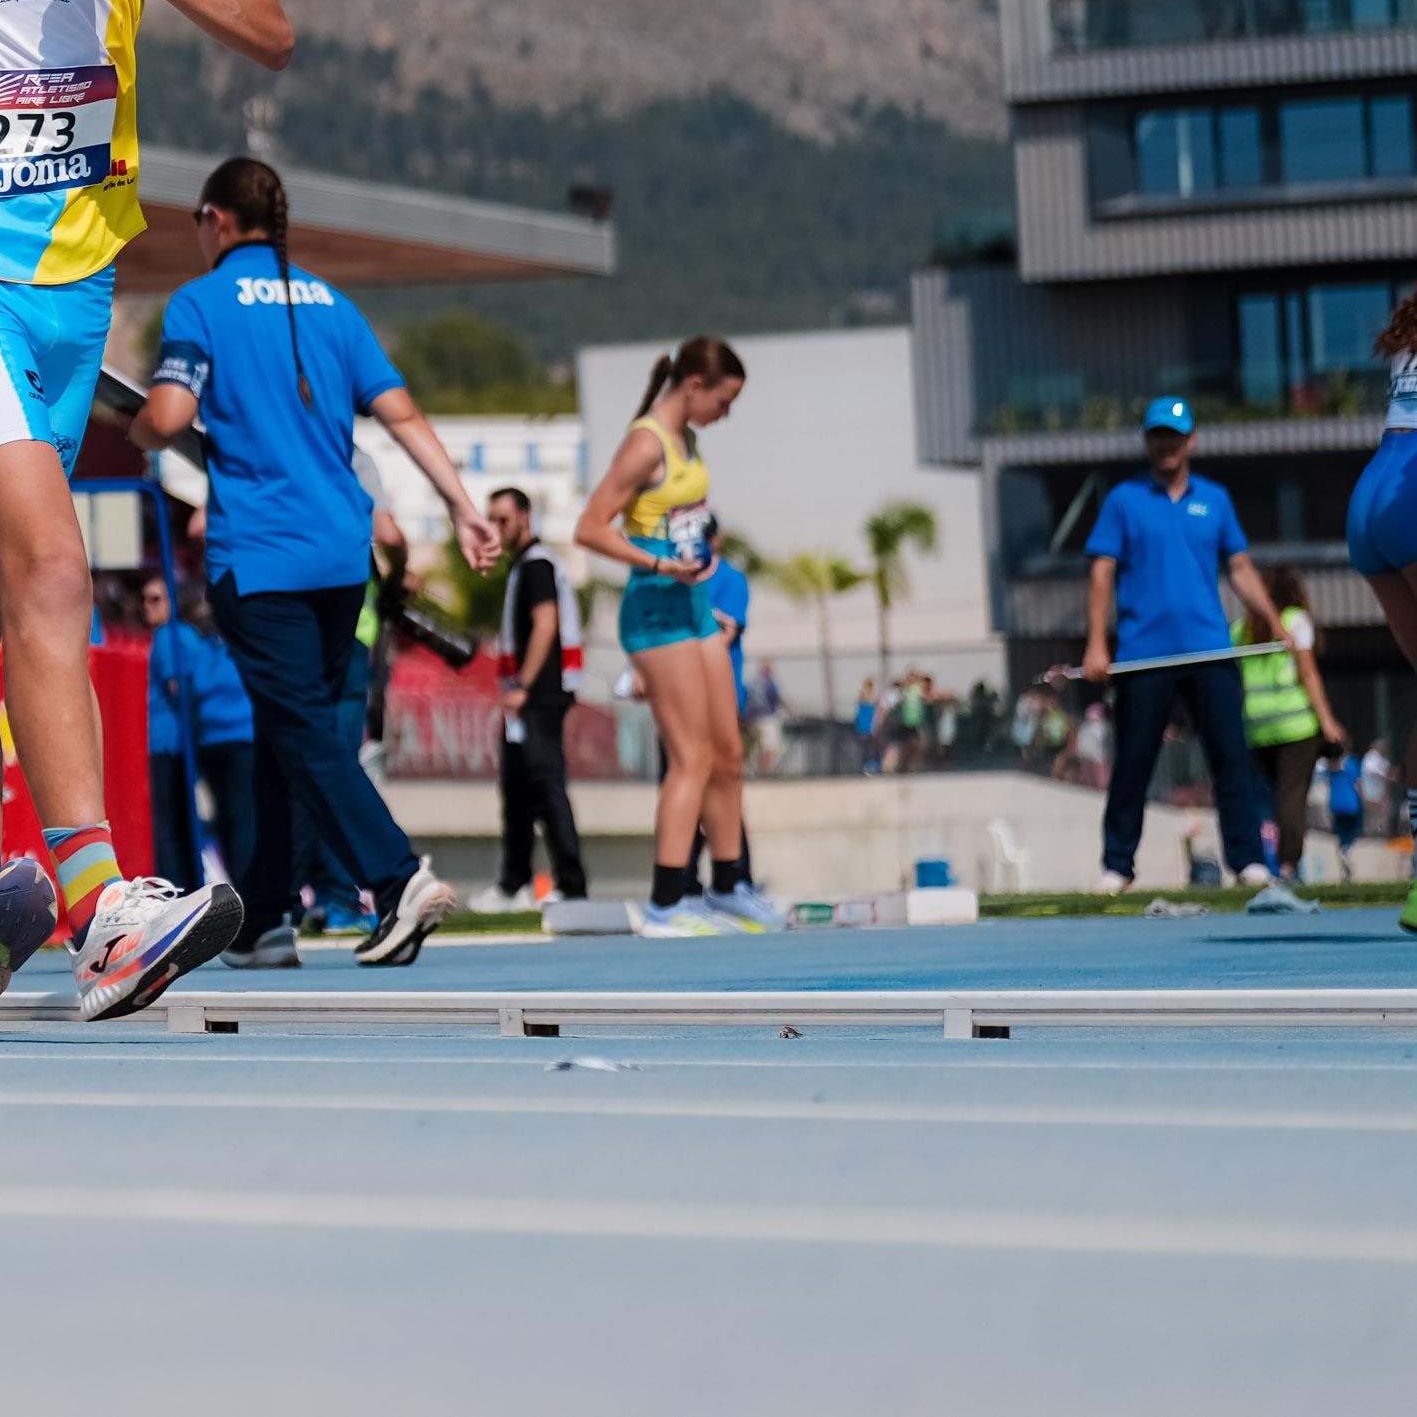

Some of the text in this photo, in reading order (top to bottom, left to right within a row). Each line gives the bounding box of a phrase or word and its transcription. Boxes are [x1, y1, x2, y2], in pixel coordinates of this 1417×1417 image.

[24, 72, 75, 85] RFEA
[19, 80, 93, 95] ATLETISMO
[15, 92, 86, 105] AIRE LIBRE
[235, 276, 334, 307] Joma
